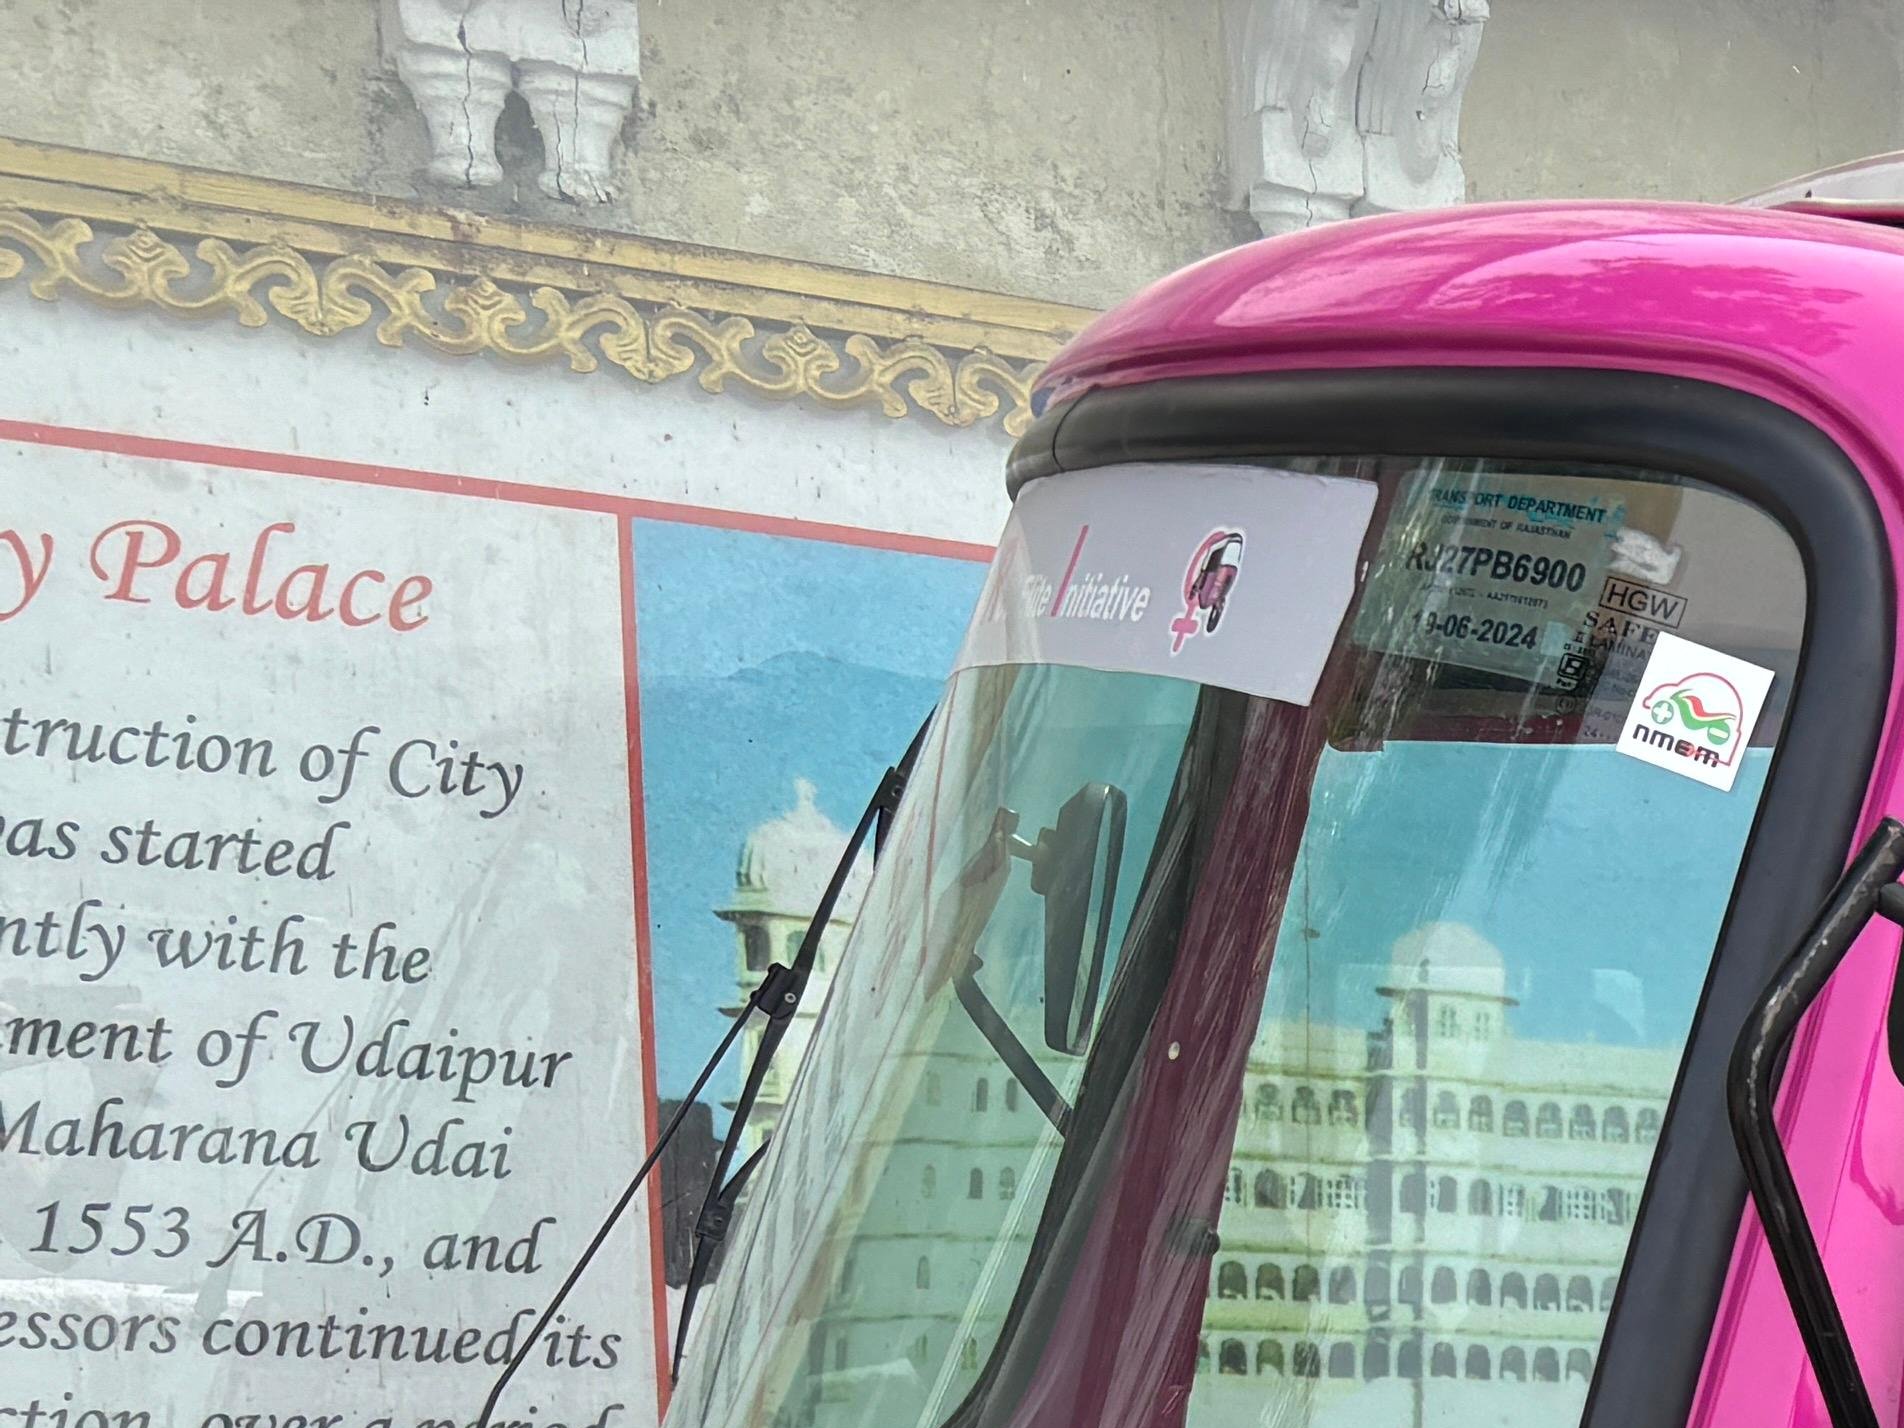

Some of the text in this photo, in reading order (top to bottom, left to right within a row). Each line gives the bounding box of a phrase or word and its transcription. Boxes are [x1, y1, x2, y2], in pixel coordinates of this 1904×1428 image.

[1507, 496, 1608, 524] DEPARTMENT
[89, 518, 434, 632] Palace
[1405, 540, 1588, 594] RJ27PB6900
[1412, 609, 1539, 651] 19-06-2024
[1605, 583, 1679, 622] HGW
[299, 725, 382, 803] of
[389, 738, 525, 819] City
[100, 820, 353, 883] started
[147, 914, 310, 980] with
[332, 921, 431, 984] the
[198, 1009, 276, 1089] of
[289, 1015, 574, 1103] Udaipur
[345, 1118, 512, 1182] Udai
[29, 1205, 556, 1280] 1553 A.D., and
[202, 1306, 535, 1367] continued
[543, 1317, 623, 1371] its
